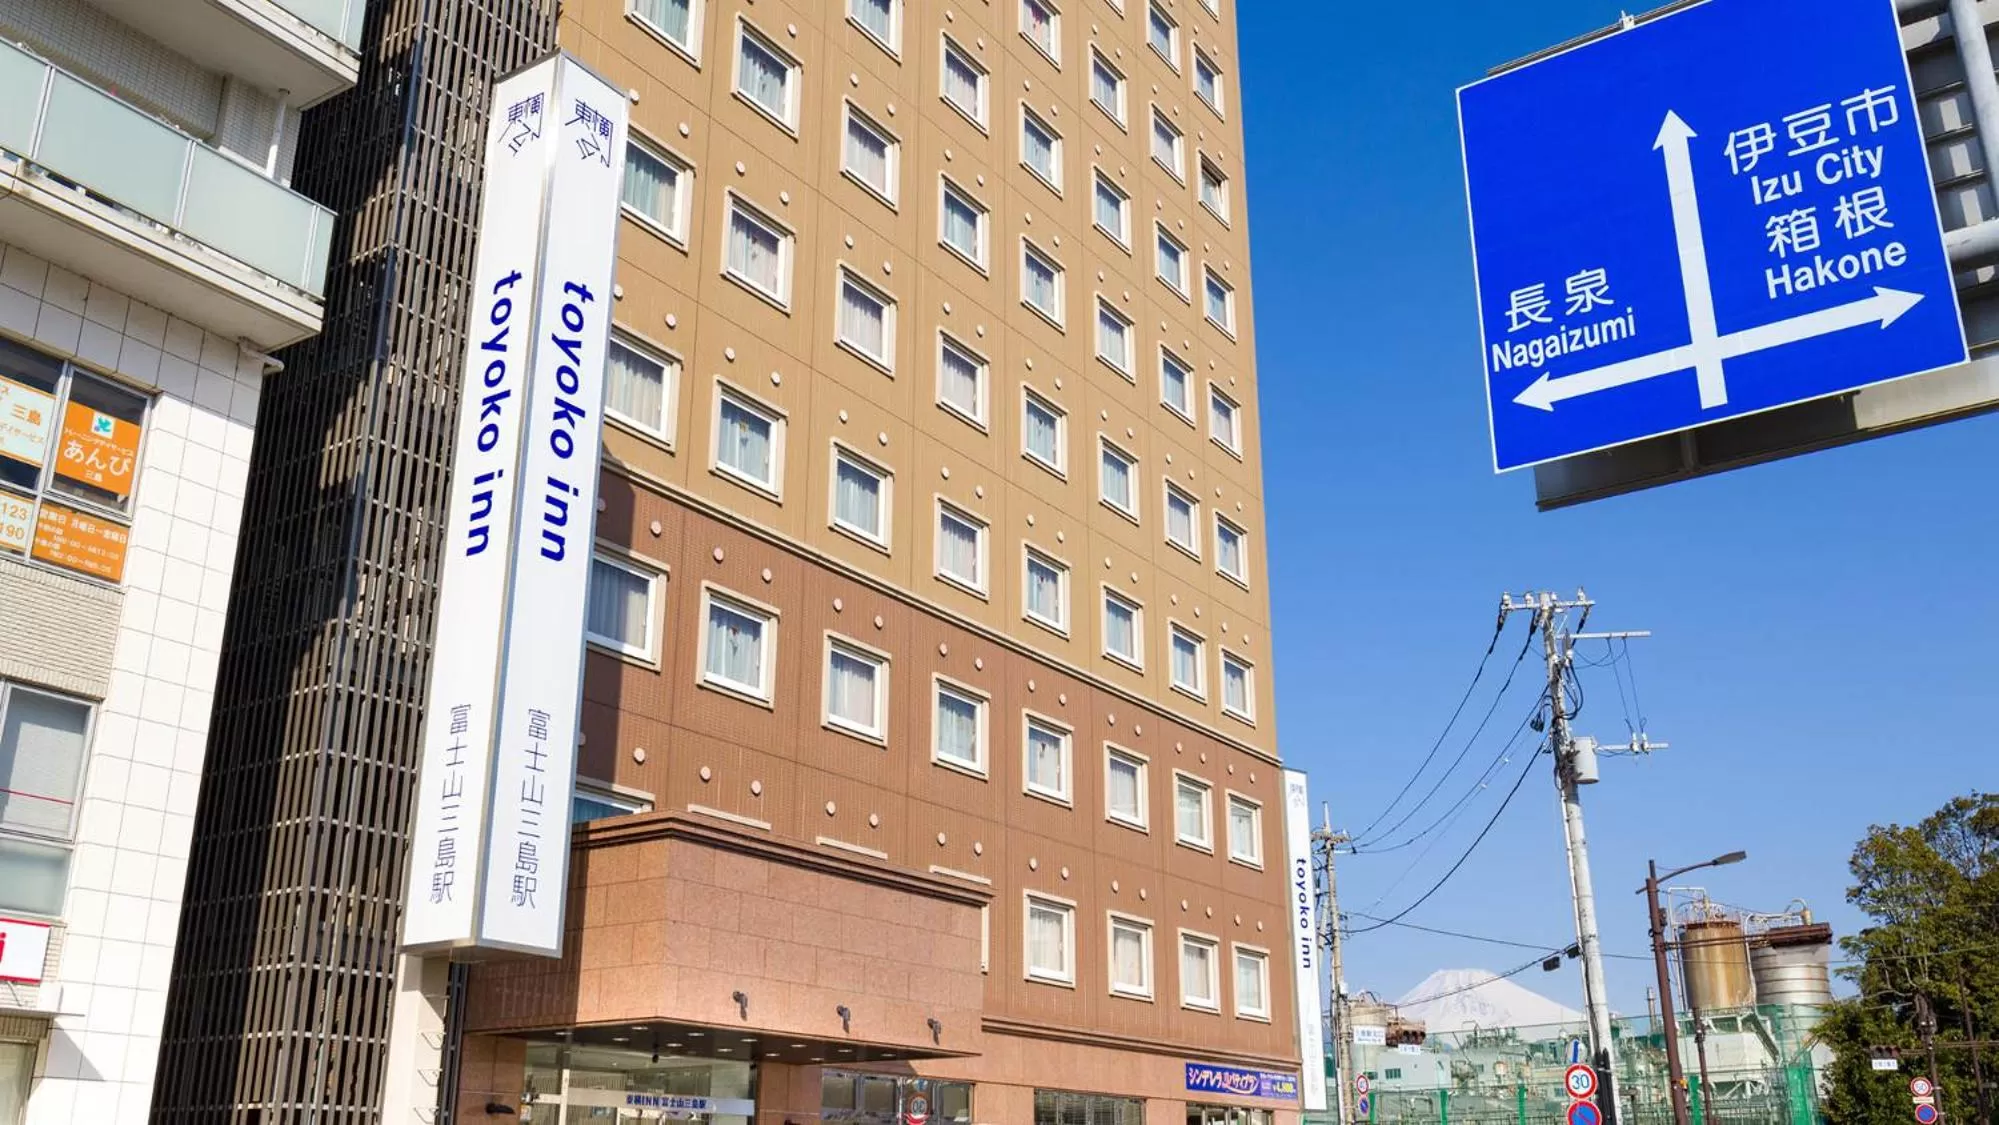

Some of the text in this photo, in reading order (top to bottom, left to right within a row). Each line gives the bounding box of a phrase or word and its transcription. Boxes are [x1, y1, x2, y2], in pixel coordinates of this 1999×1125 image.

[1723, 85, 1899, 175] 伊豆市
[1751, 145, 1884, 205] Izu City
[1764, 186, 1895, 259] 箱根
[1504, 267, 1615, 333] 長泉
[1765, 241, 1908, 300] Hakone
[1492, 306, 1636, 373] Nagaizumi
[466, 270, 523, 557] toyoko inn
[540, 281, 595, 562] toyoko inn
[63, 440, 132, 477] あんび
[430, 703, 472, 905] 富士山三島駅
[511, 708, 551, 909] 富士山三島駅
[1295, 858, 1312, 969] toyoko inn
[1571, 1074, 1590, 1090] 30
